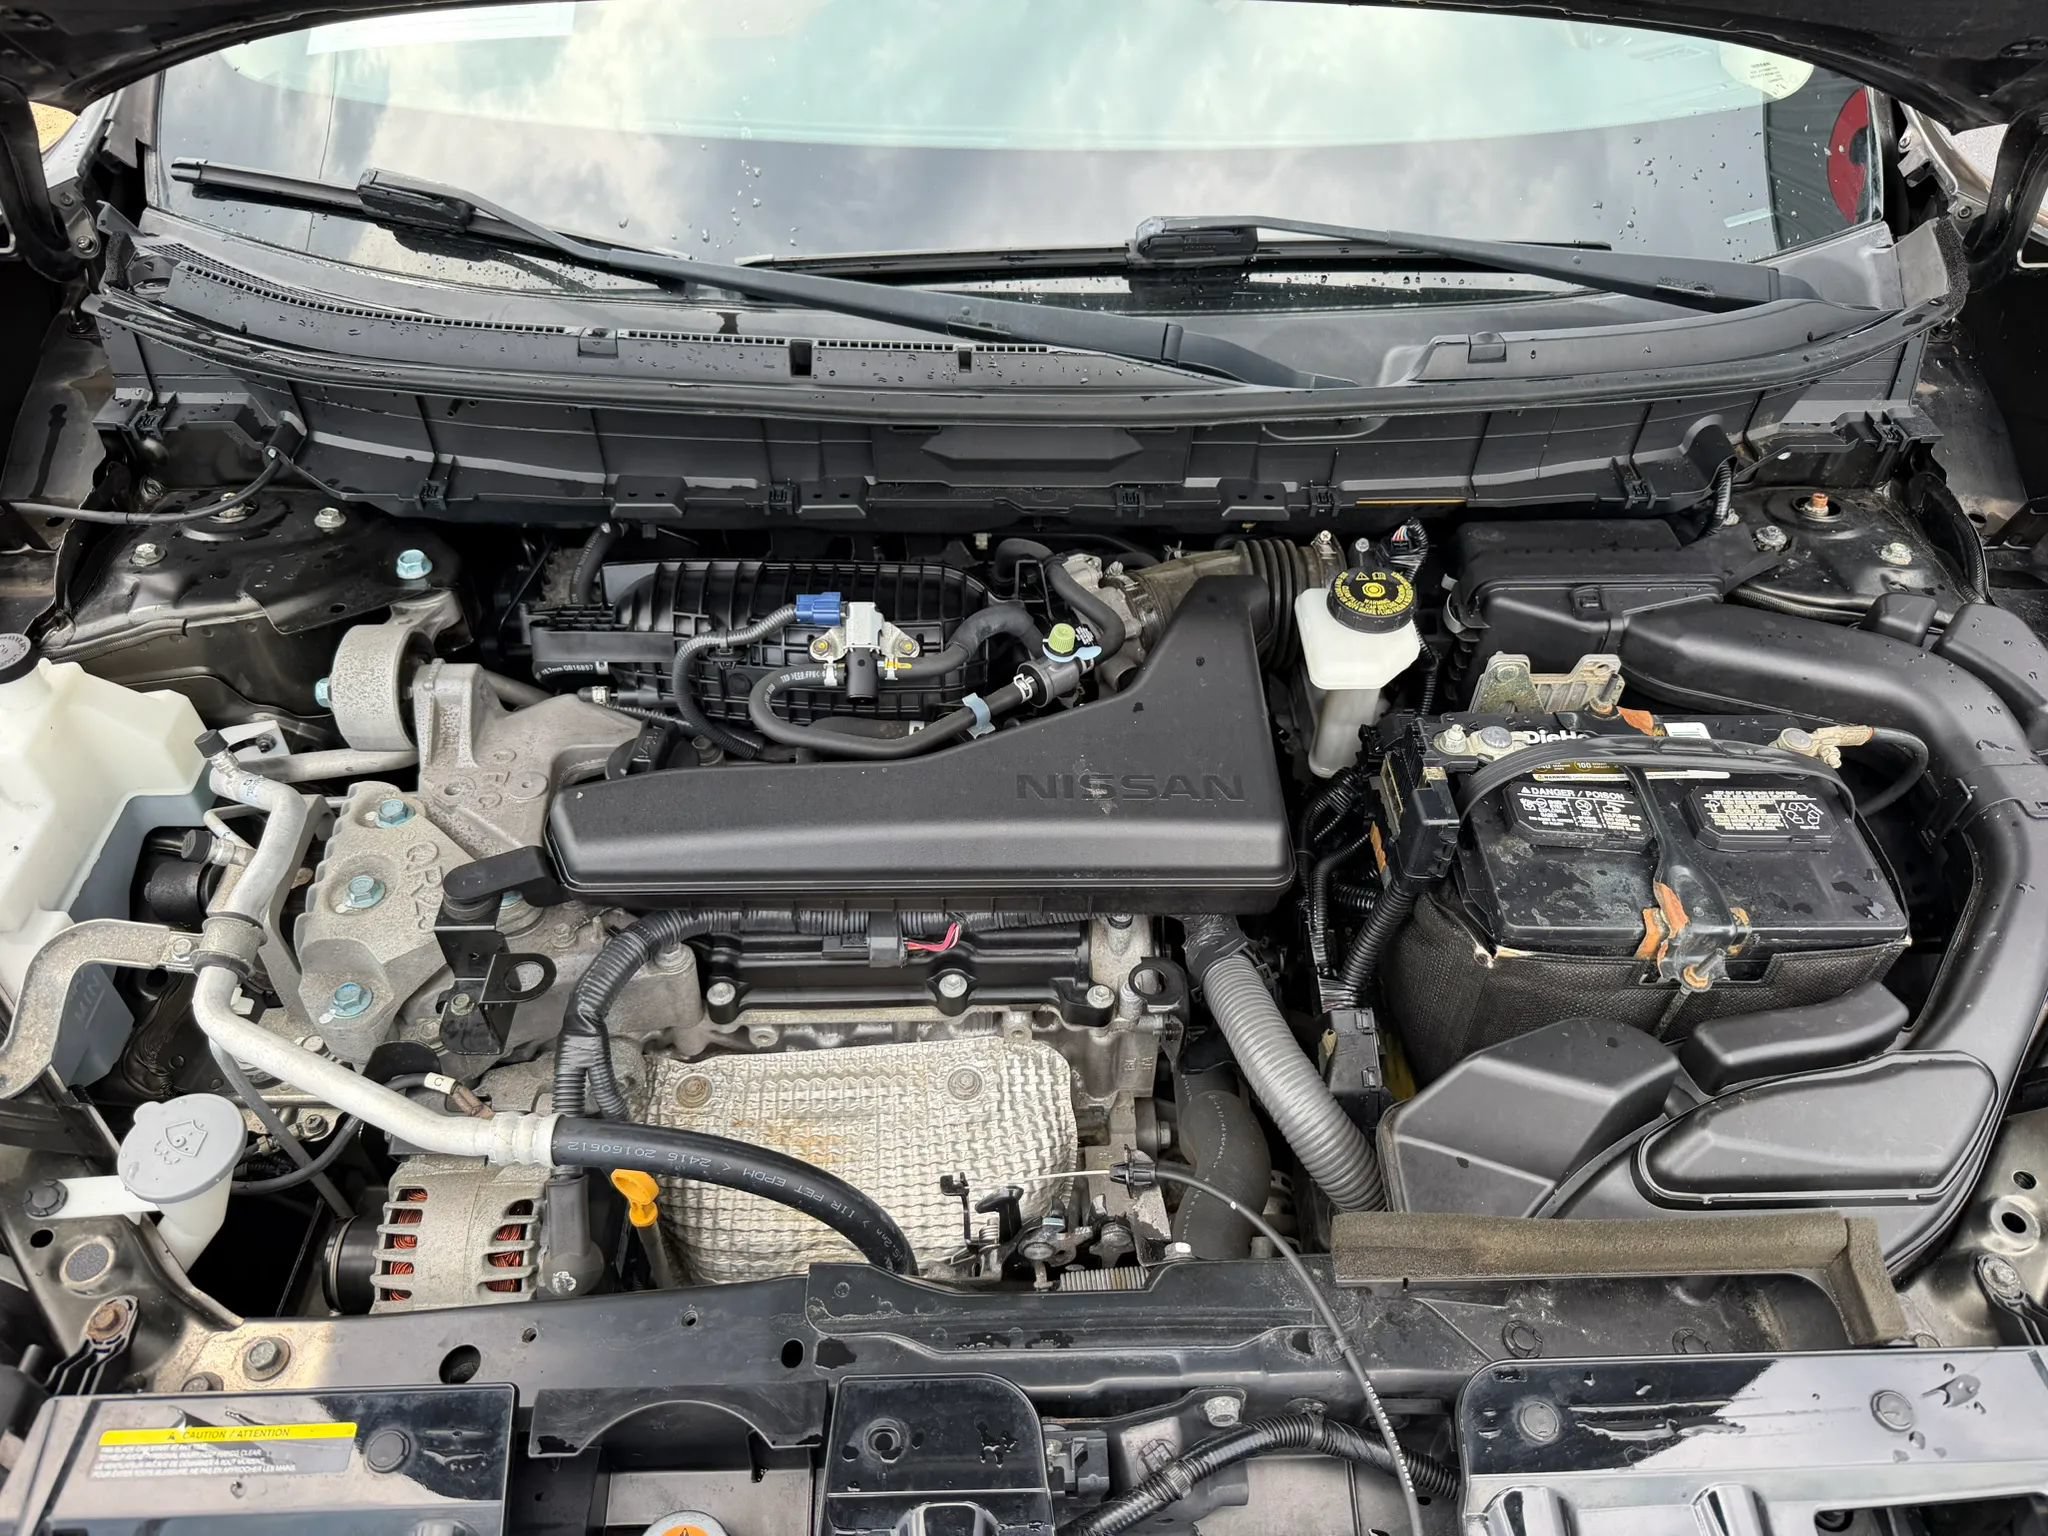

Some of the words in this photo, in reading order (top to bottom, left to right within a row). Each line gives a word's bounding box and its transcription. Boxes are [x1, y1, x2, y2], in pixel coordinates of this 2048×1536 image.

[1016, 774, 1245, 801] NISSAN
[1530, 787, 1576, 797] DANGER
[1585, 790, 1626, 800] POISON
[667, 1152, 712, 1167] 2416
[742, 1167, 787, 1188] EPDM
[793, 1185, 825, 1202] PET
[182, 1430, 227, 1440] CAUTION
[237, 1428, 291, 1438] ATTENTION
